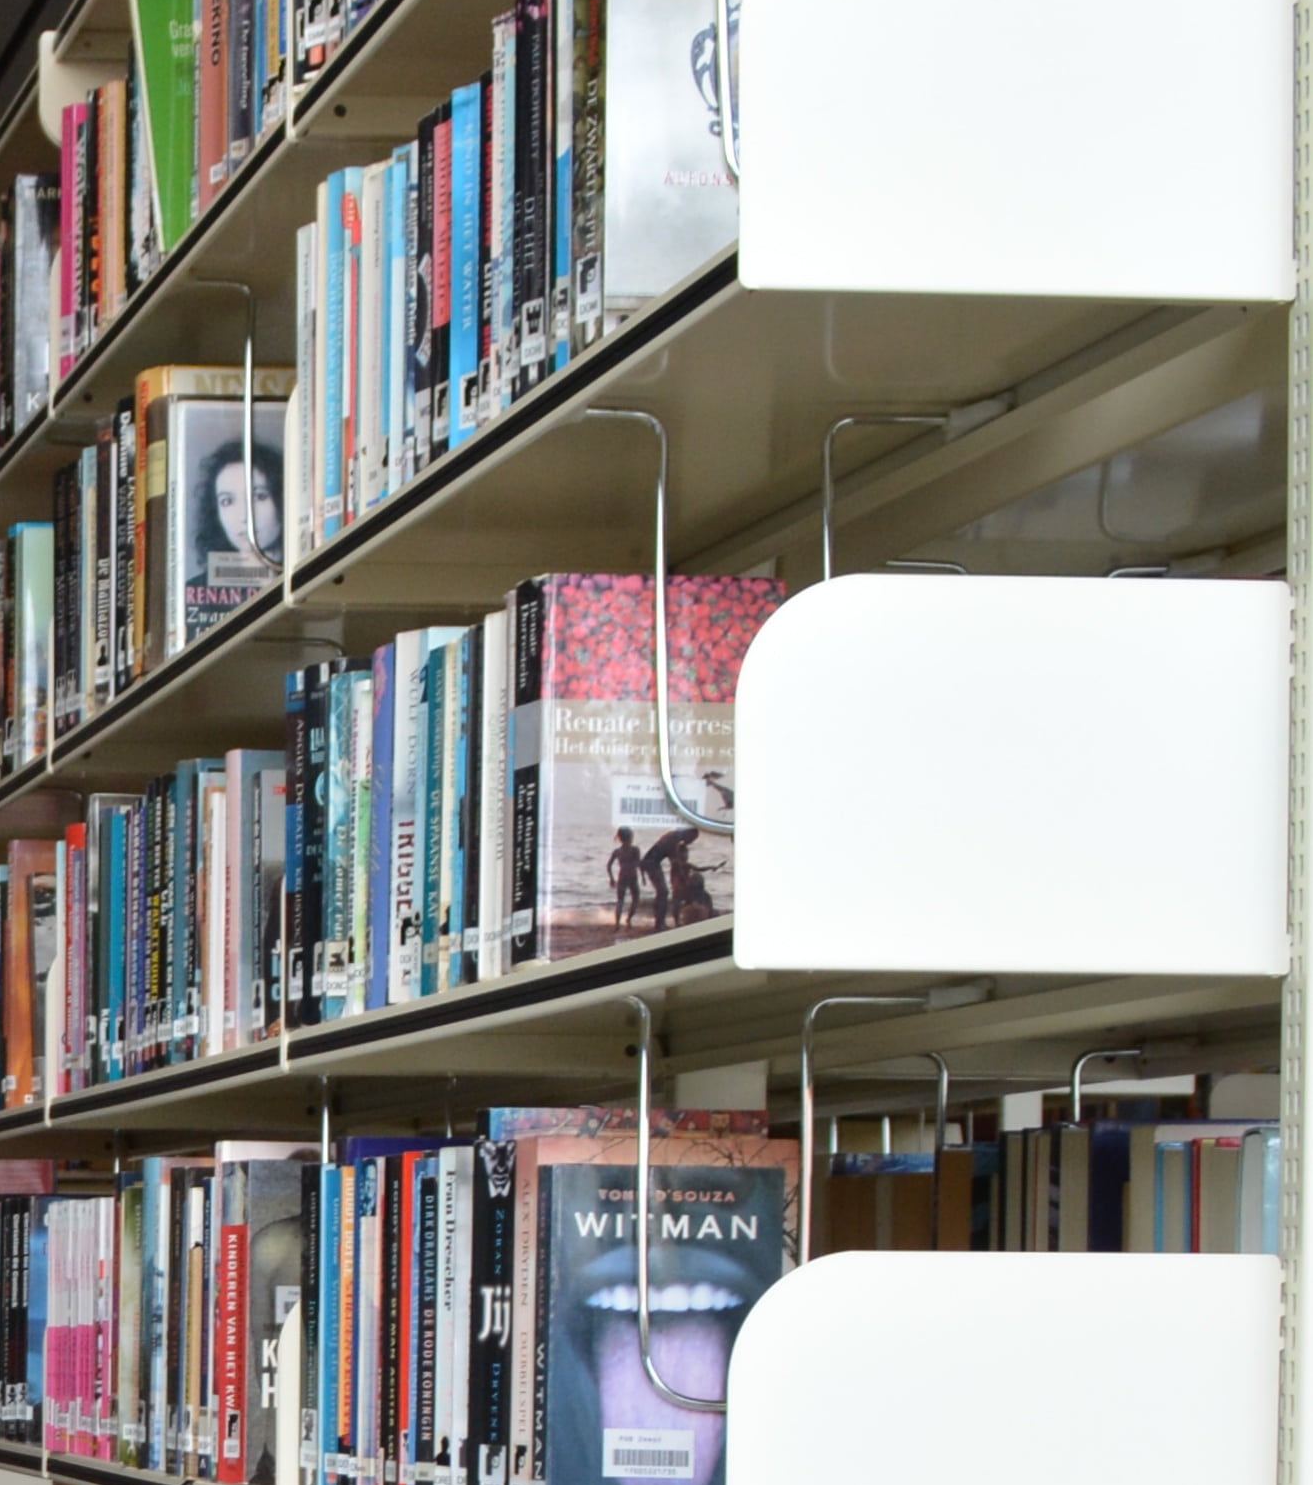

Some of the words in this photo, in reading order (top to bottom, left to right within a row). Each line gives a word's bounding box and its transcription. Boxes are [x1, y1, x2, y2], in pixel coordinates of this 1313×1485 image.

[460, 260, 475, 333] WATER
[185, 586, 242, 605] RENAN
[554, 706, 641, 733] Renate
[649, 709, 735, 735] orres
[405, 734, 418, 796] DORN
[421, 1194, 435, 1228] DIRK
[519, 1177, 531, 1223] ALEX
[225, 1233, 239, 1312] KINDEREN
[420, 1230, 434, 1303] DRAULANS
[443, 1218, 456, 1313] Drescher
[517, 1226, 531, 1308] DRYDEN
[225, 1315, 238, 1347] VAN
[419, 1330, 434, 1368] RODE
[224, 1350, 238, 1381] HET
[418, 1371, 433, 1443] KONINGIN
